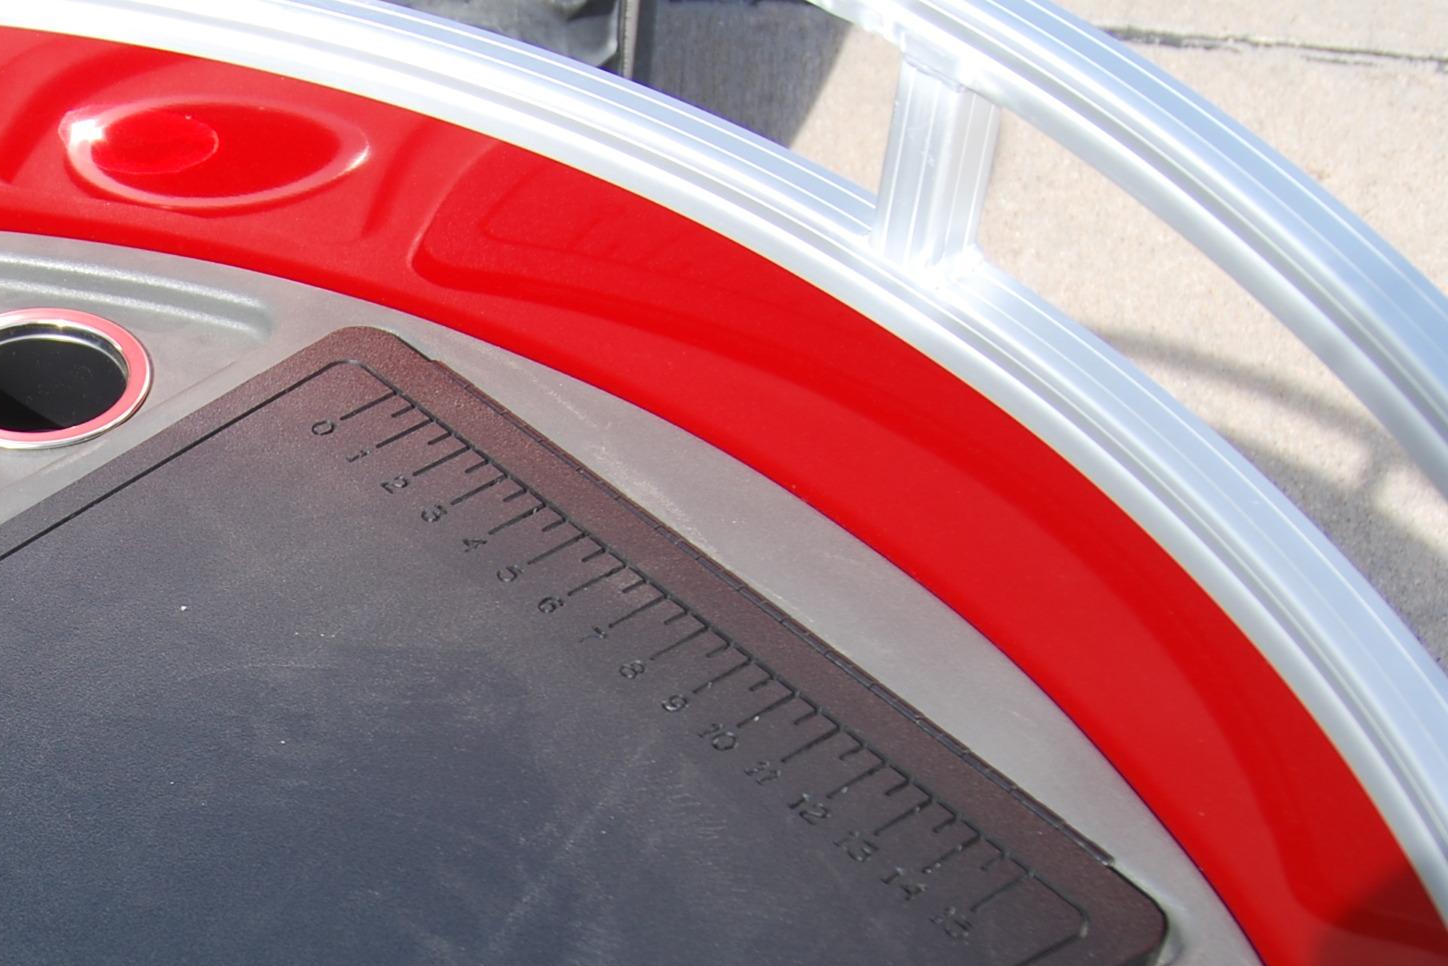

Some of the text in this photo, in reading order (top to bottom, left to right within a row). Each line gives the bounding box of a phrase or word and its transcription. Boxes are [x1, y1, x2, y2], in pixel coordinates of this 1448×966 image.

[381, 475, 409, 494] 2
[421, 504, 447, 523] 3
[462, 537, 488, 552] 4
[497, 564, 523, 583] 5
[538, 596, 564, 614] 6
[619, 660, 645, 679] 8
[662, 694, 688, 712] 9
[698, 722, 737, 752] 10
[788, 792, 830, 825] 12
